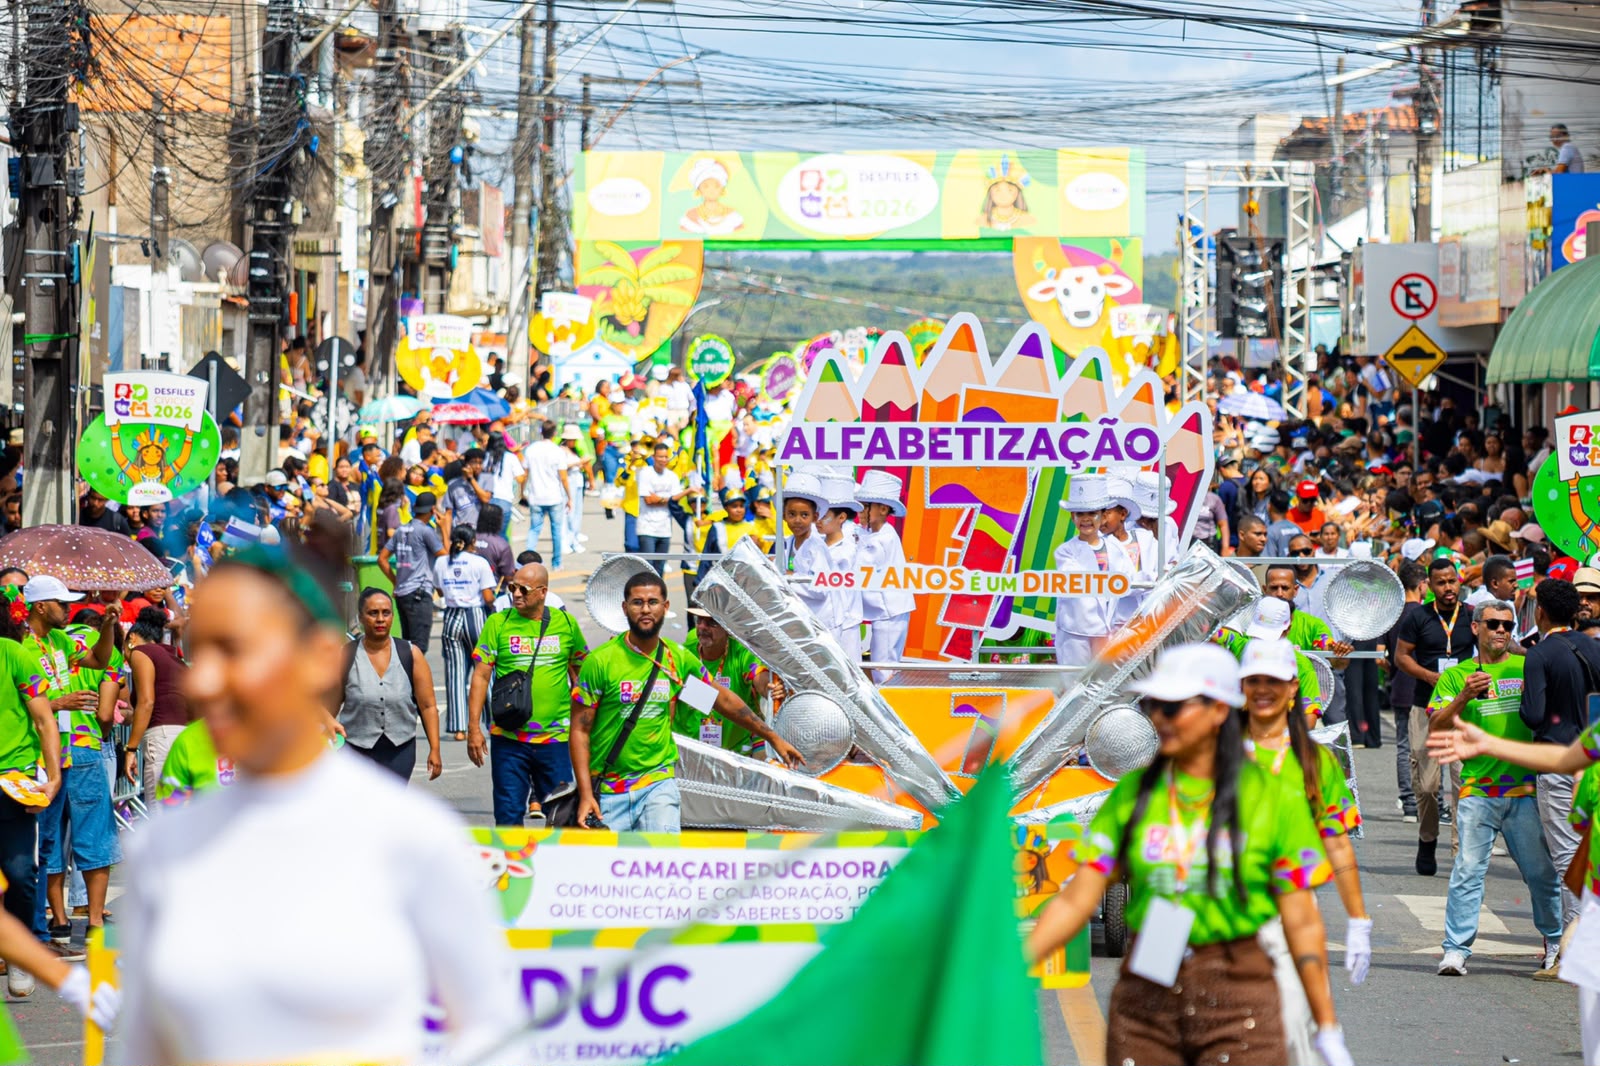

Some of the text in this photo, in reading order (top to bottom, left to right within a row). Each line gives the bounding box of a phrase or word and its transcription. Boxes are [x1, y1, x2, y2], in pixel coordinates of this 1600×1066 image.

[860, 199, 918, 217] 2026
[154, 387, 196, 397] DESFILES
[154, 404, 193, 419] 2026
[779, 417, 1161, 470] ALFABETIZAÇÃO
[814, 566, 1130, 595] AOS 7 ANOS É UM DIREITO
[610, 859, 894, 884] CAMAÇARI EDUCADORA
[556, 882, 693, 902] COMUNICAÇÃO
[697, 886, 708, 901] E
[712, 882, 852, 903] COLABORAÇÃO,
[549, 903, 587, 919] QUE
[591, 904, 692, 921] CONECTAM
[696, 906, 721, 920] OS
[725, 905, 802, 921] SABERES
[806, 906, 844, 921] DOS
